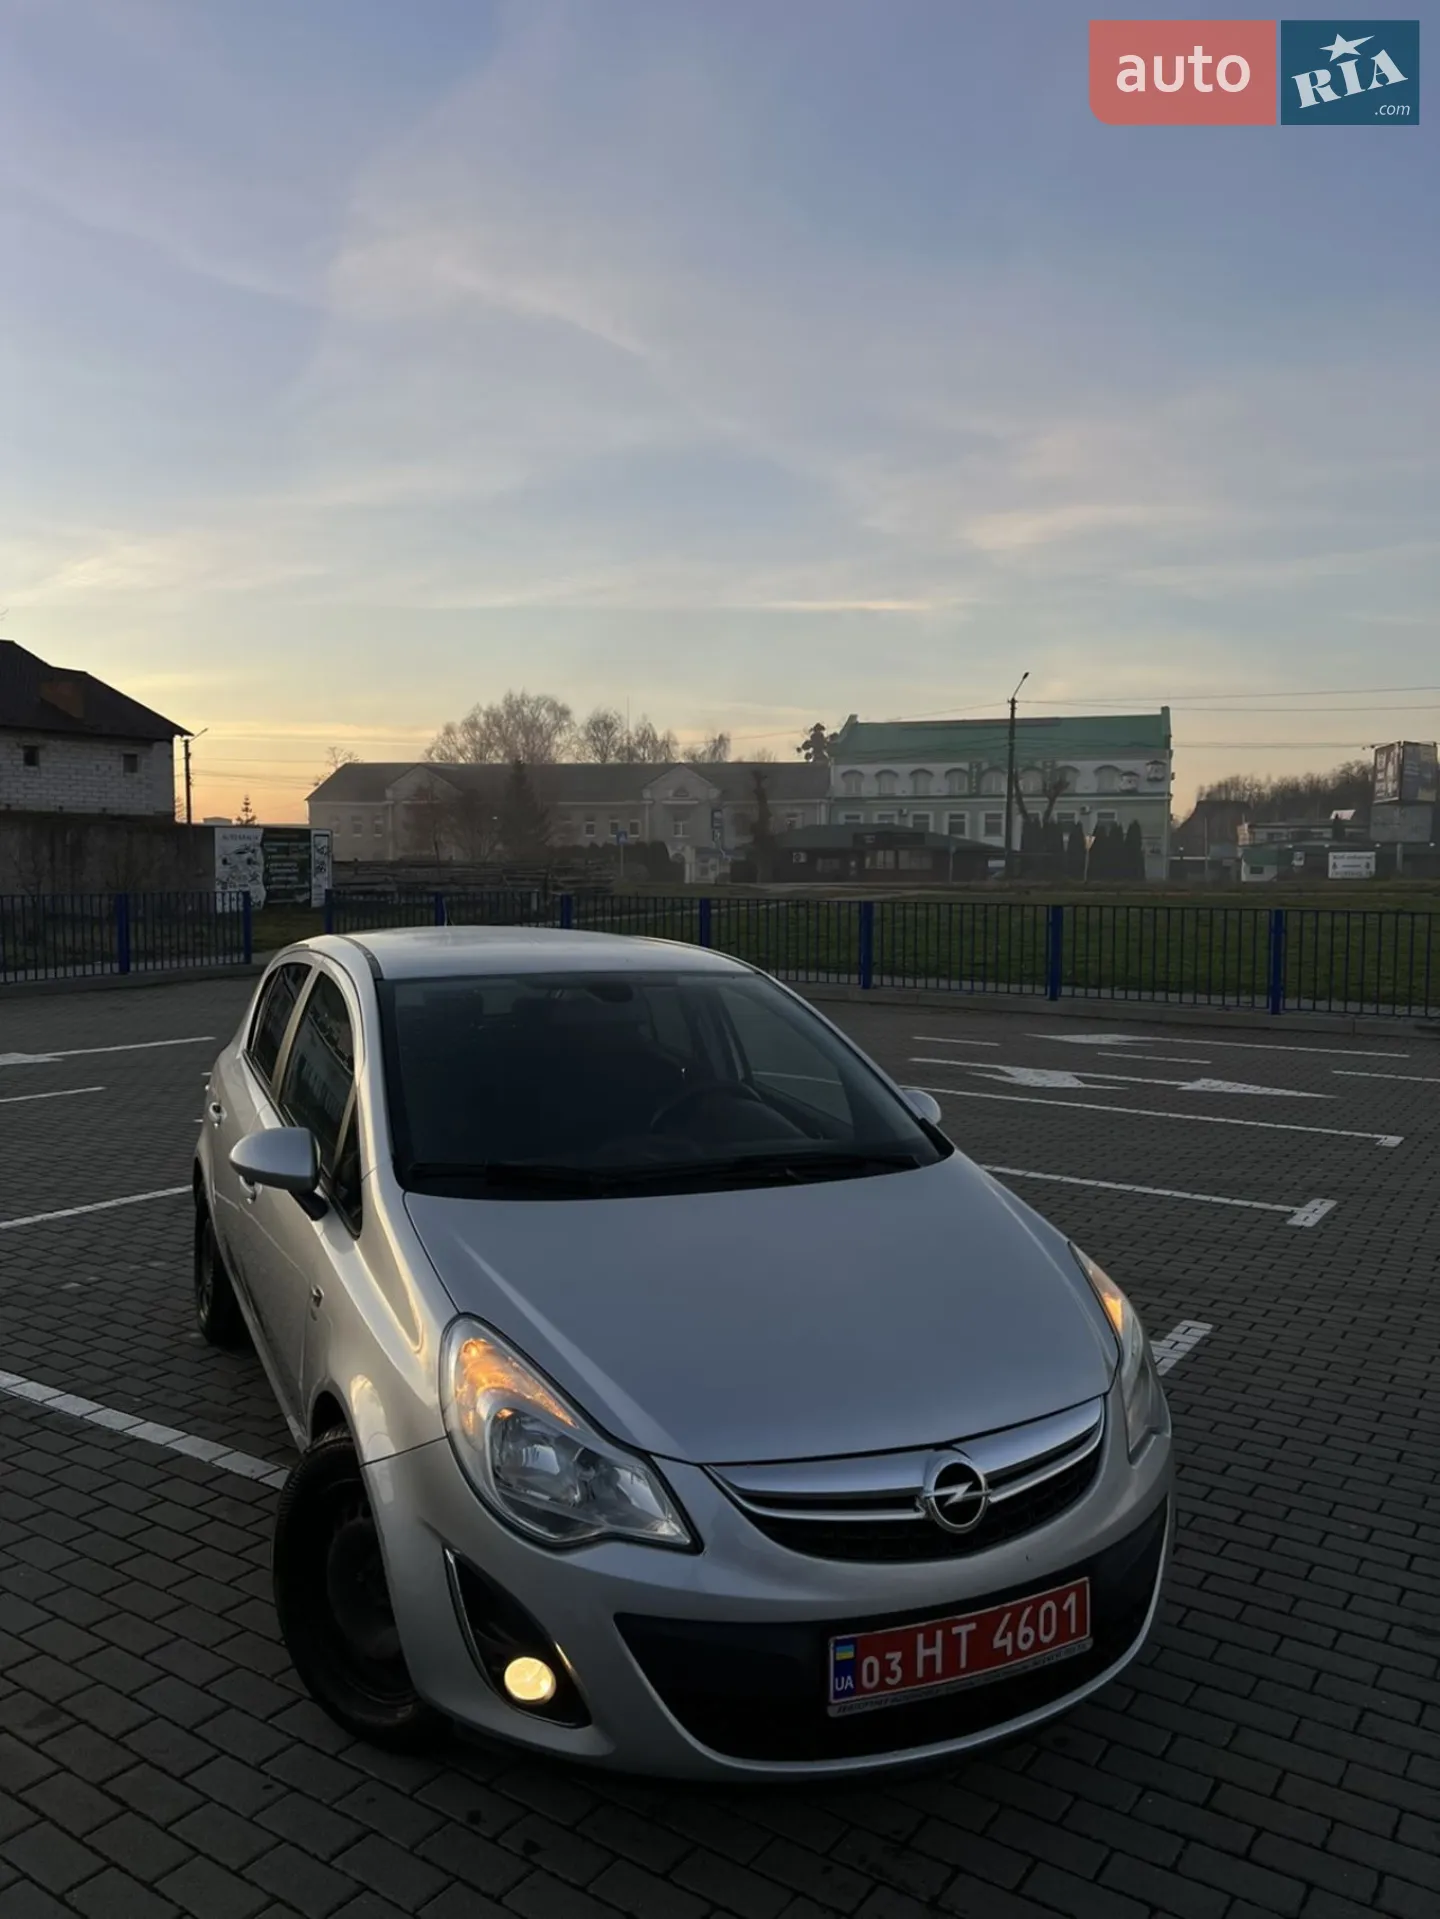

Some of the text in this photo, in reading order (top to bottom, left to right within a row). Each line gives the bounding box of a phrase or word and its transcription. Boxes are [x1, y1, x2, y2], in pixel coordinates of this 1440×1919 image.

[862, 1651, 902, 1689] 03
[916, 1622, 977, 1679] HT
[992, 1591, 1078, 1656] 4601
[835, 1675, 854, 1692] UA
